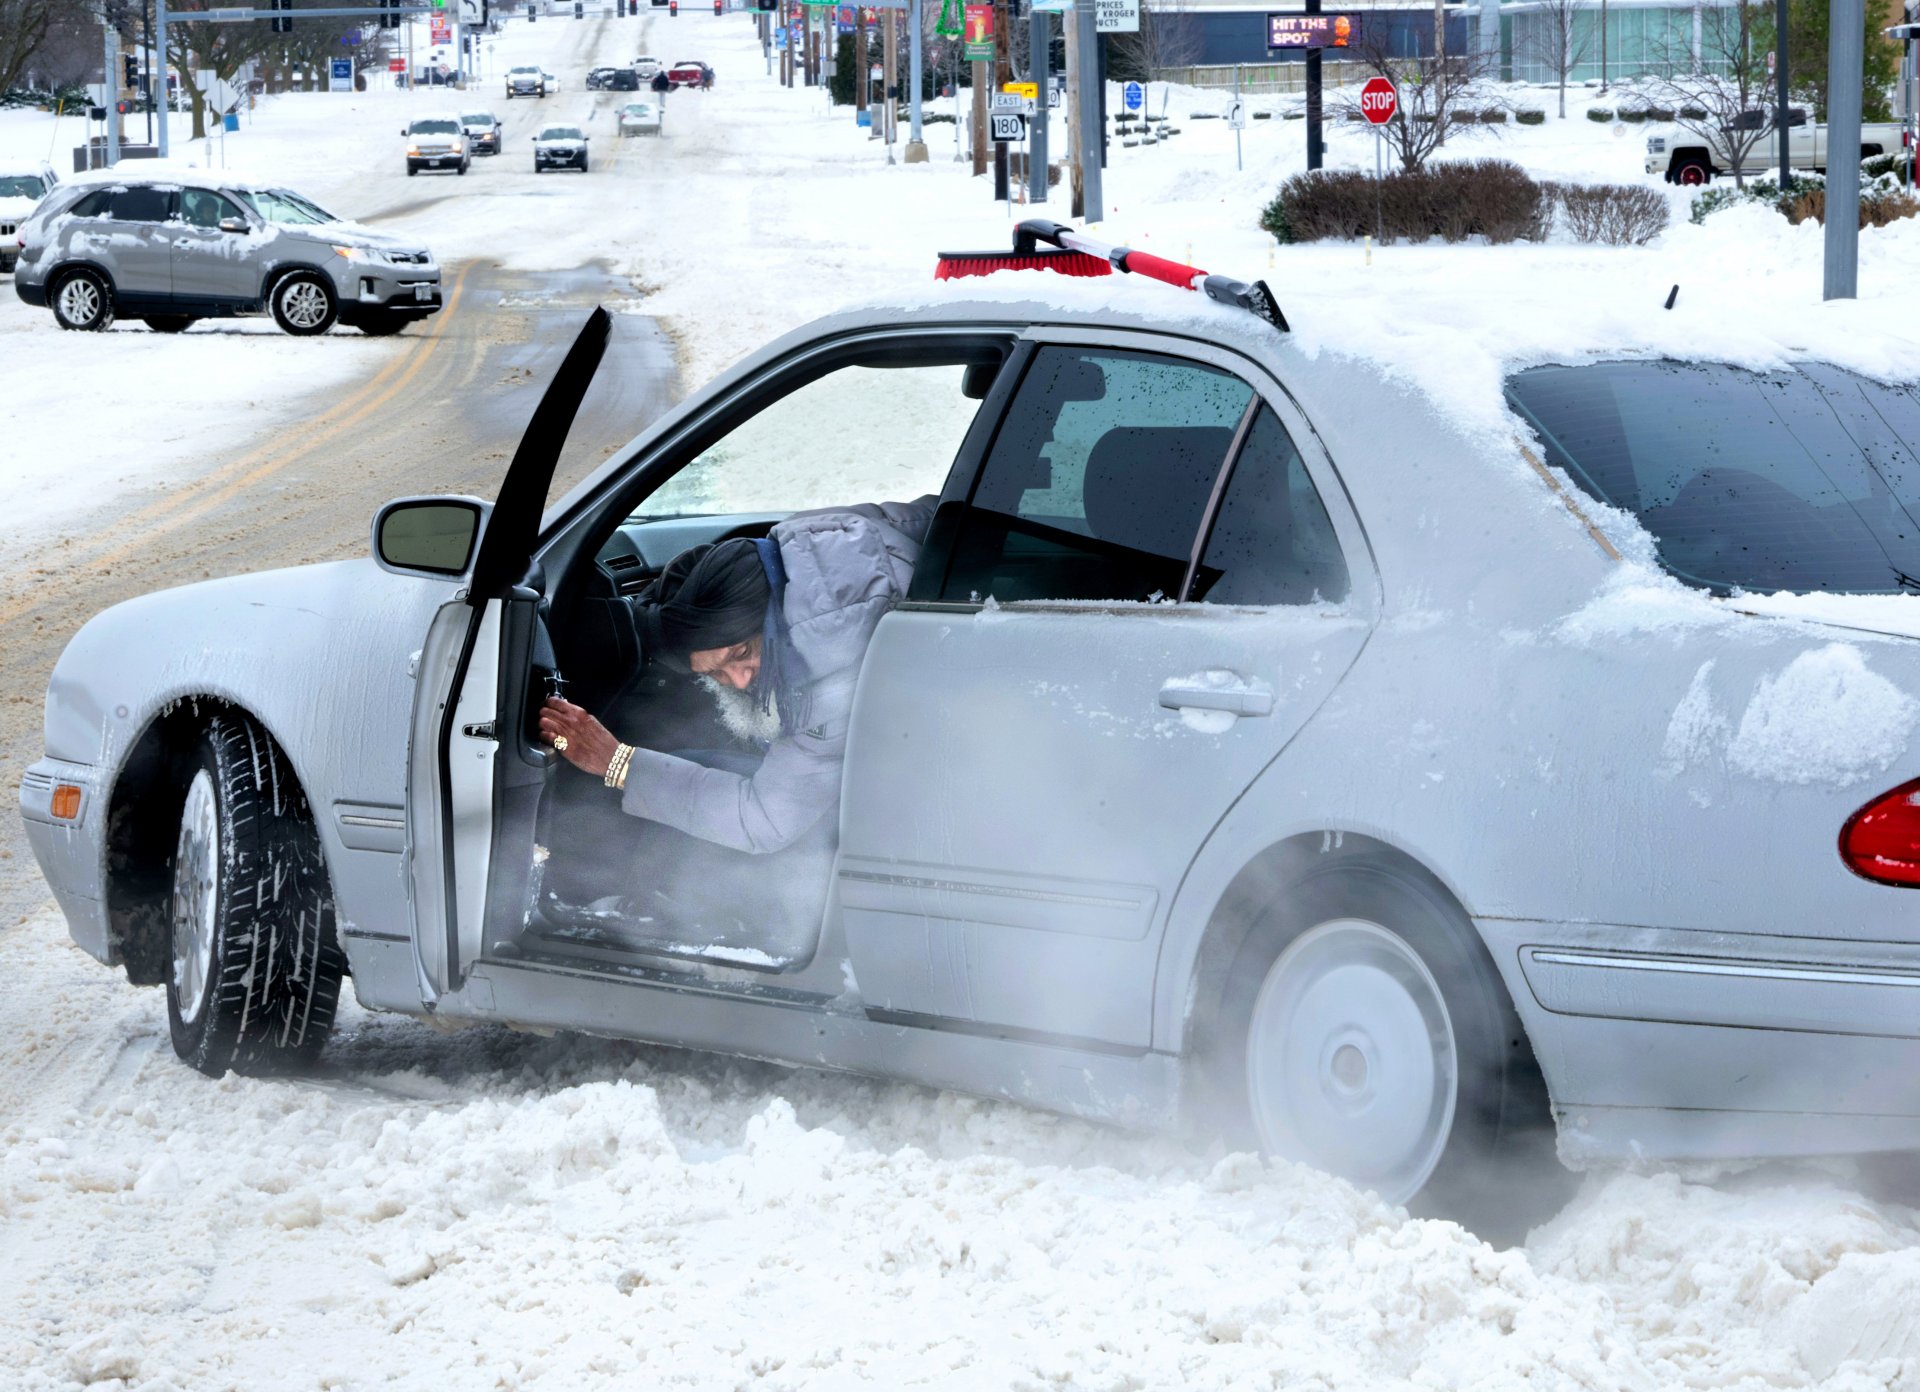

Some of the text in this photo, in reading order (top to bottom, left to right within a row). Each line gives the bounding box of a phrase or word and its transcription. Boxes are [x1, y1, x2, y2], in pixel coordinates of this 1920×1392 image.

[1096, 1, 1124, 9] PRICES
[1103, 10, 1135, 18] KROGER
[1096, 19, 1119, 27] UCTS
[1273, 18, 1327, 30] HIT THE
[1273, 32, 1312, 44] SPOT
[997, 96, 1018, 106] EAST
[1363, 91, 1394, 111] STOP
[997, 118, 1019, 134] 180
